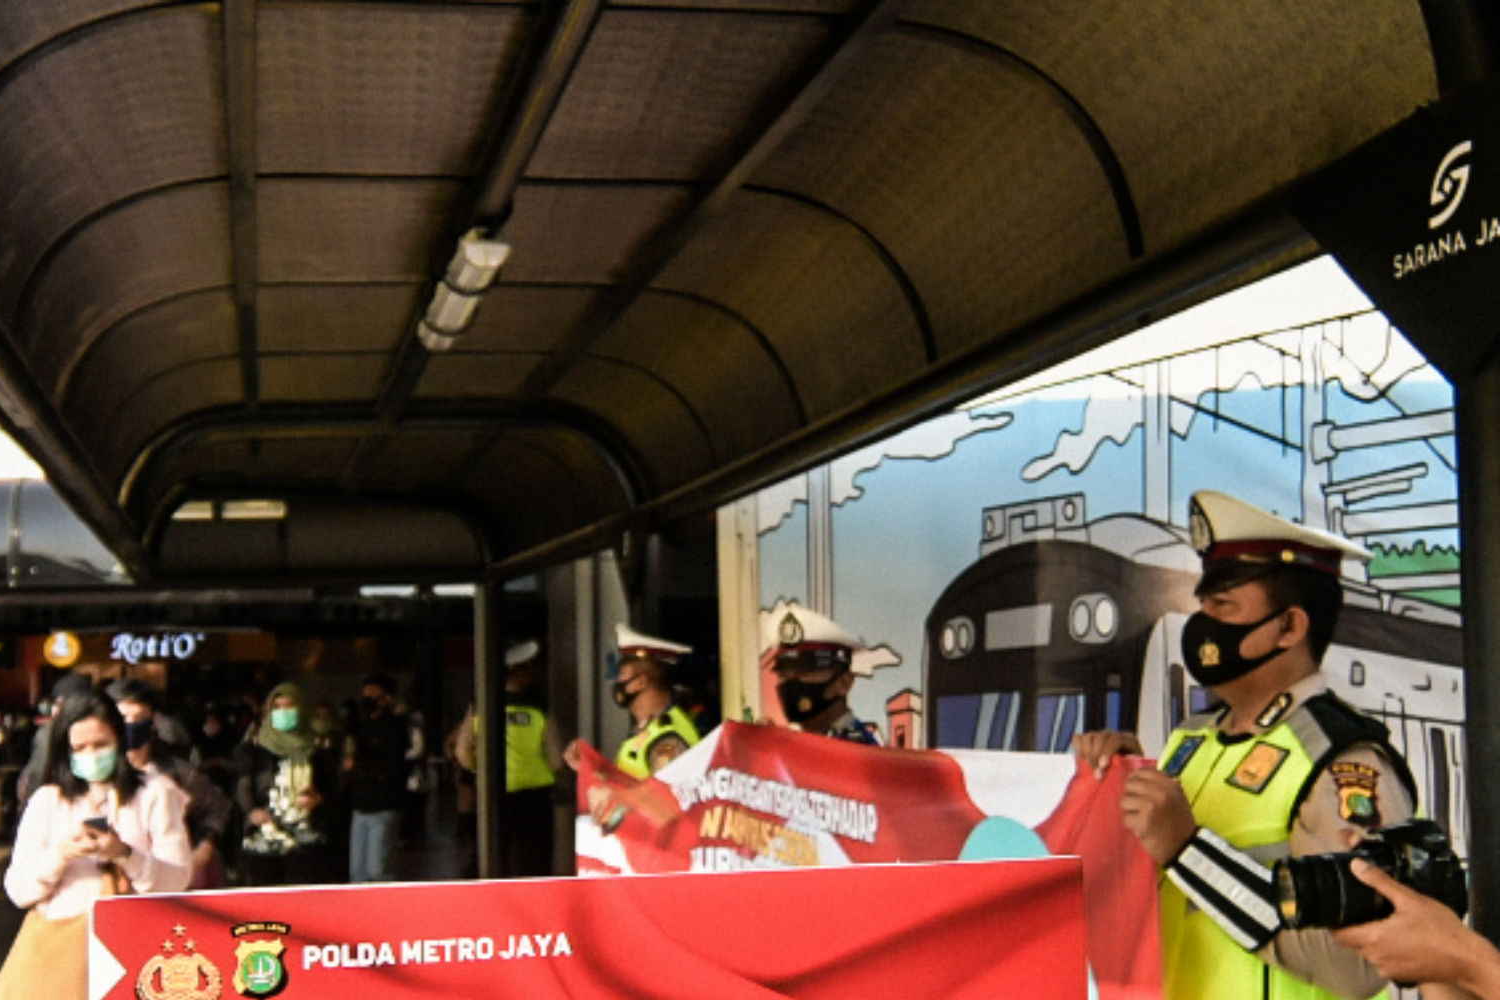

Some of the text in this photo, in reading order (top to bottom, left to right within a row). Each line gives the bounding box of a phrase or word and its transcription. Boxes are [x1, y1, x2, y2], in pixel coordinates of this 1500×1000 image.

[1392, 230, 1467, 279] SARANA
[302, 932, 573, 970] POLDA METRO JAYA
